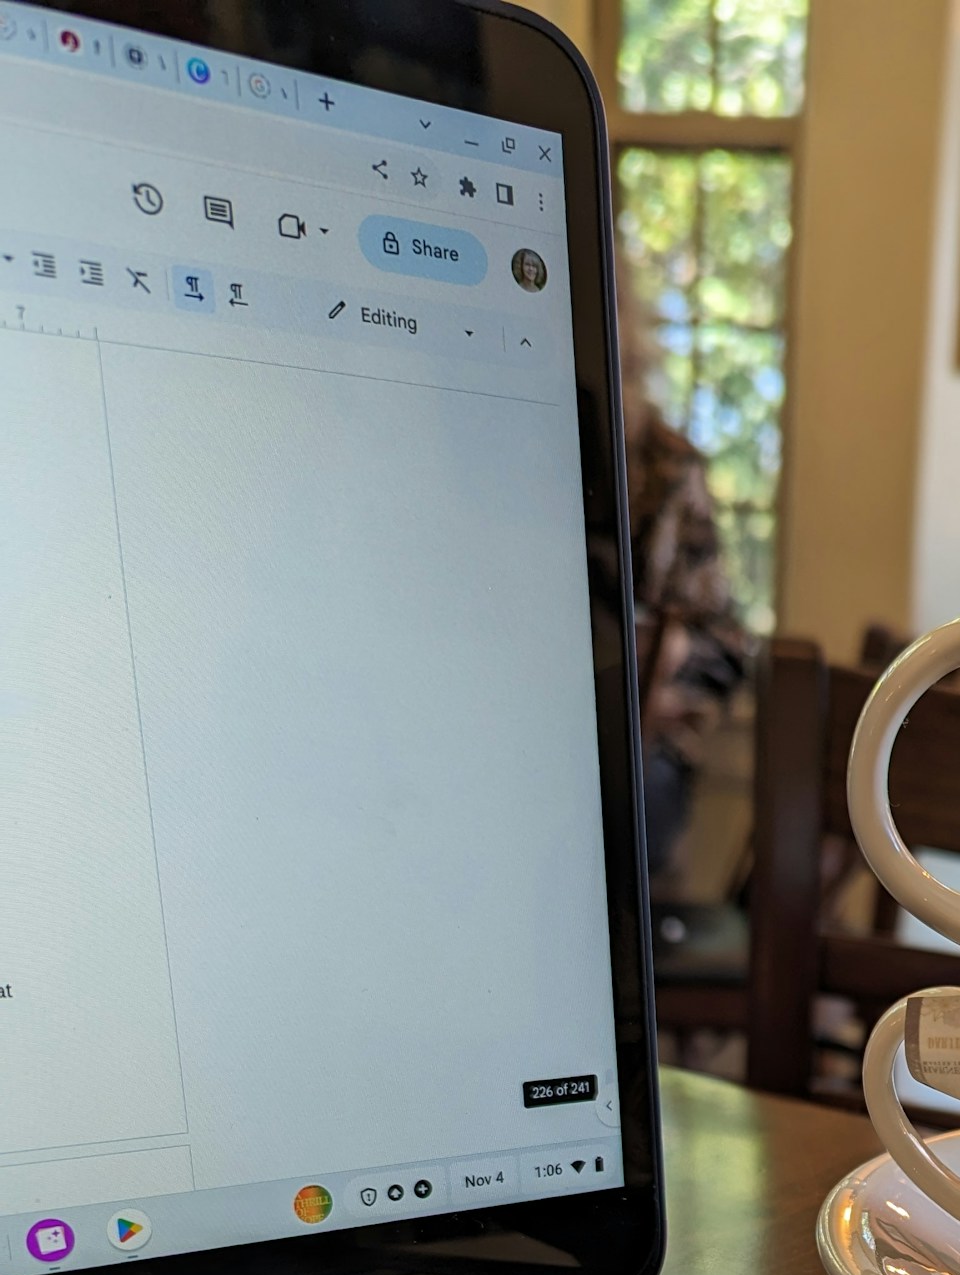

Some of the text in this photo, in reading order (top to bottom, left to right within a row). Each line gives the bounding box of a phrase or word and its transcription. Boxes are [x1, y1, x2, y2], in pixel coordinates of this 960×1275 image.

[412, 238, 459, 262] Share
[361, 306, 417, 335] Editing
[532, 1081, 590, 1099] 226 of 241
[464, 1170, 505, 1189] Nov 4
[534, 1162, 563, 1179] 1:06
